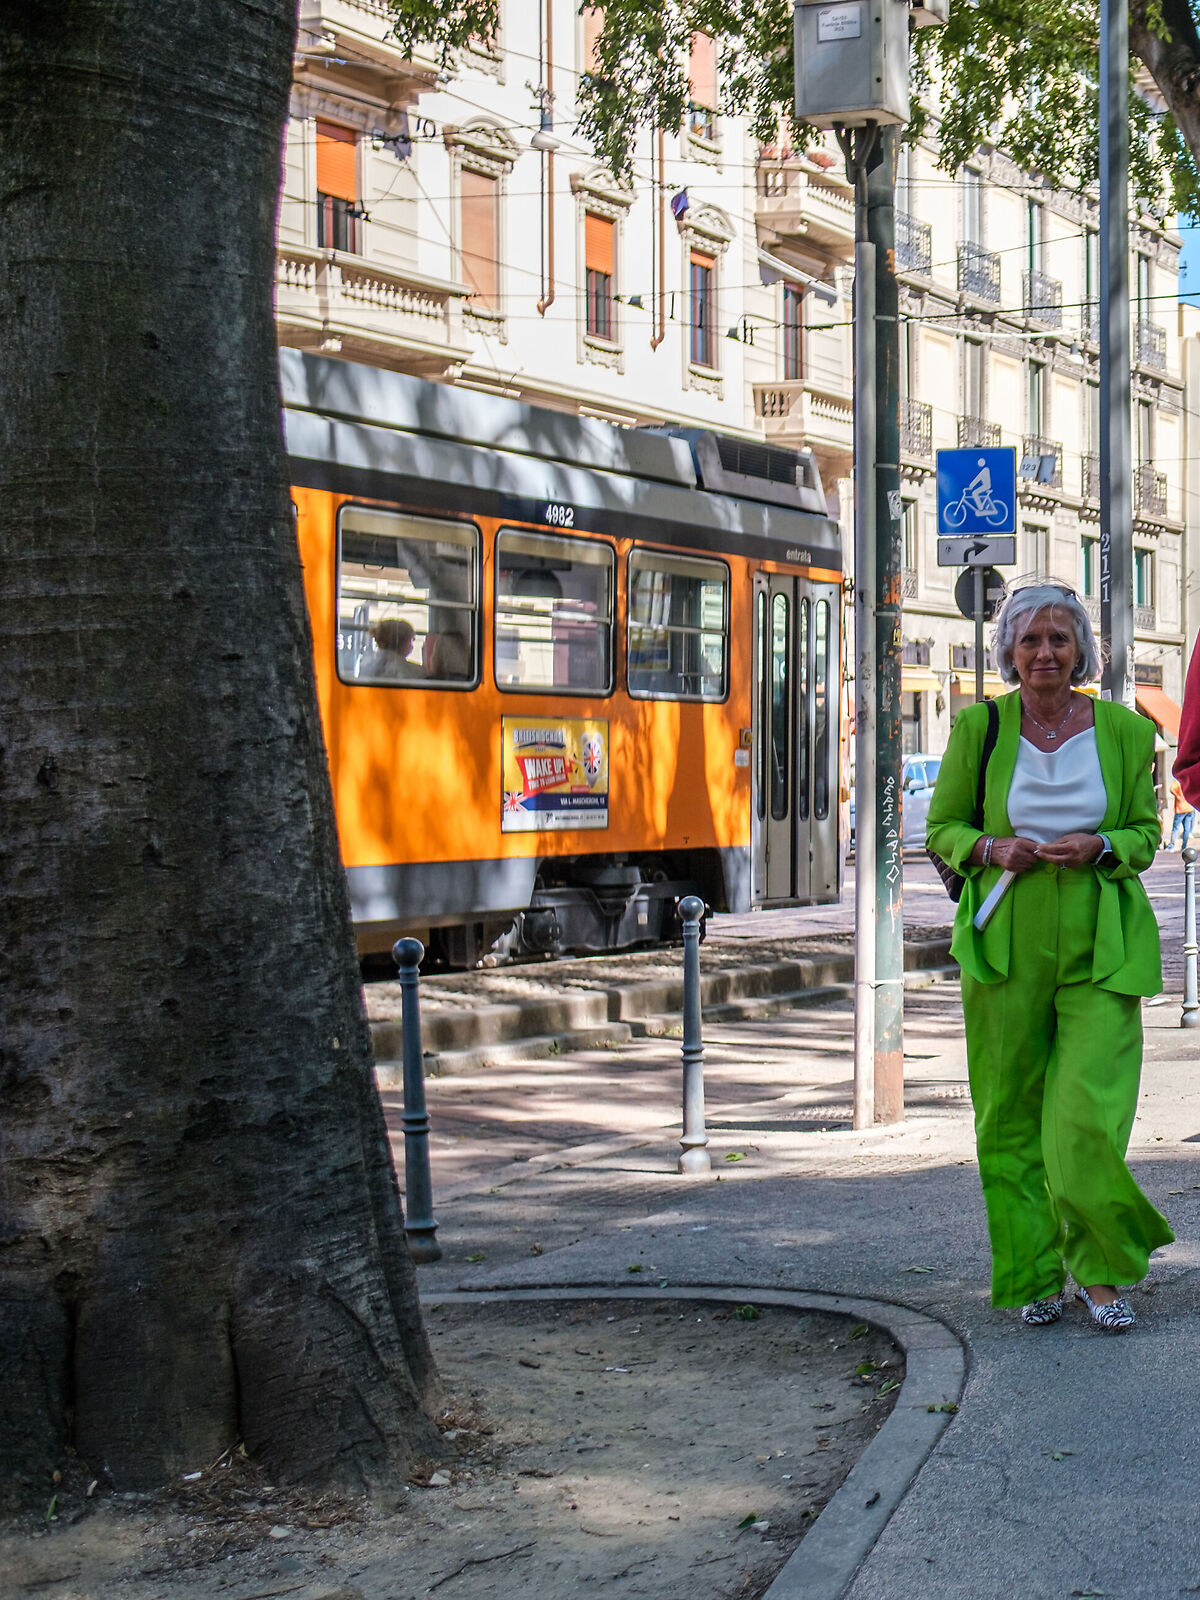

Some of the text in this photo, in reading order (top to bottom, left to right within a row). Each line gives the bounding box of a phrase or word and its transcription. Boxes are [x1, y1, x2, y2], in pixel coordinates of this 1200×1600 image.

[545, 504, 574, 527] 4982
[786, 548, 812, 564] entrata
[524, 758, 553, 779] WAKE
